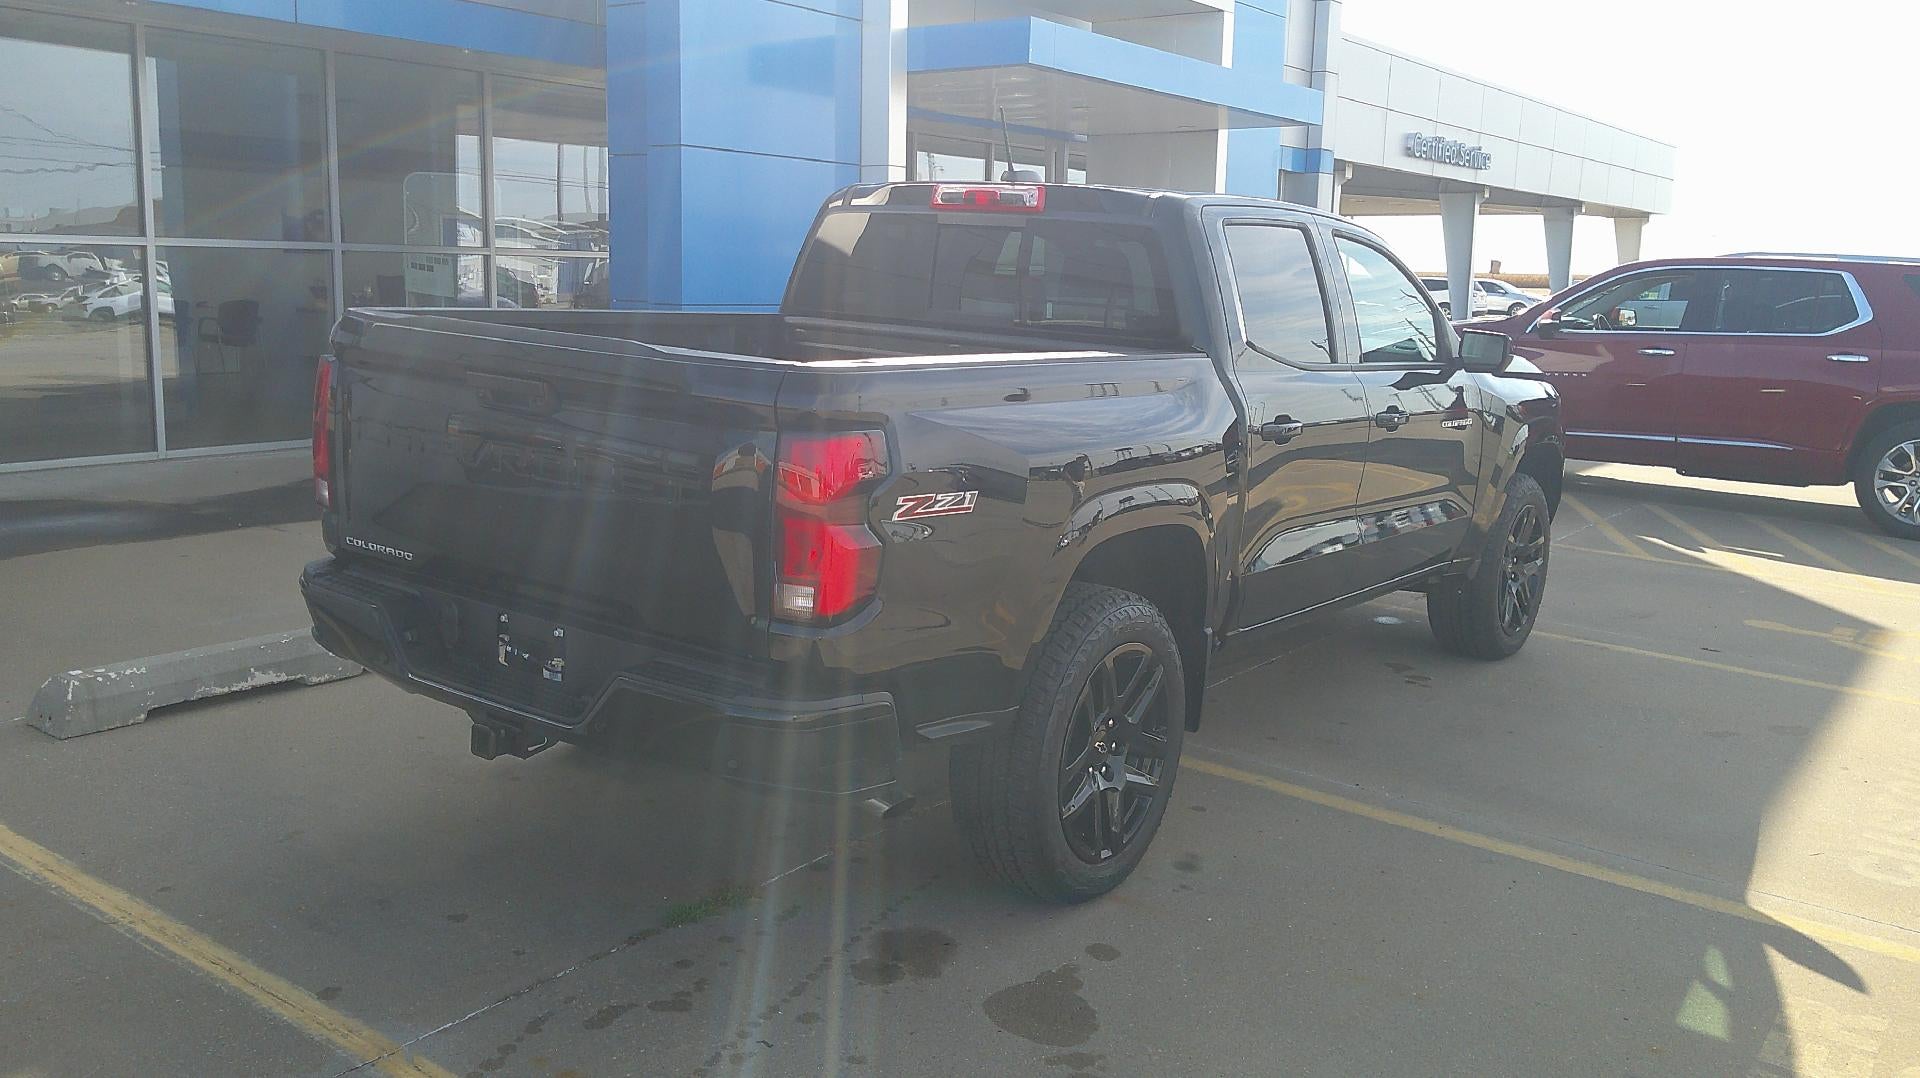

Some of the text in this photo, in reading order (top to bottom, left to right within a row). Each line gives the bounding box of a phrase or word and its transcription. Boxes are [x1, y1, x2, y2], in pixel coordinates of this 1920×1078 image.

[1413, 132, 1491, 170] Certified Service
[892, 491, 979, 521] Z71
[346, 536, 413, 561] COLORADO
